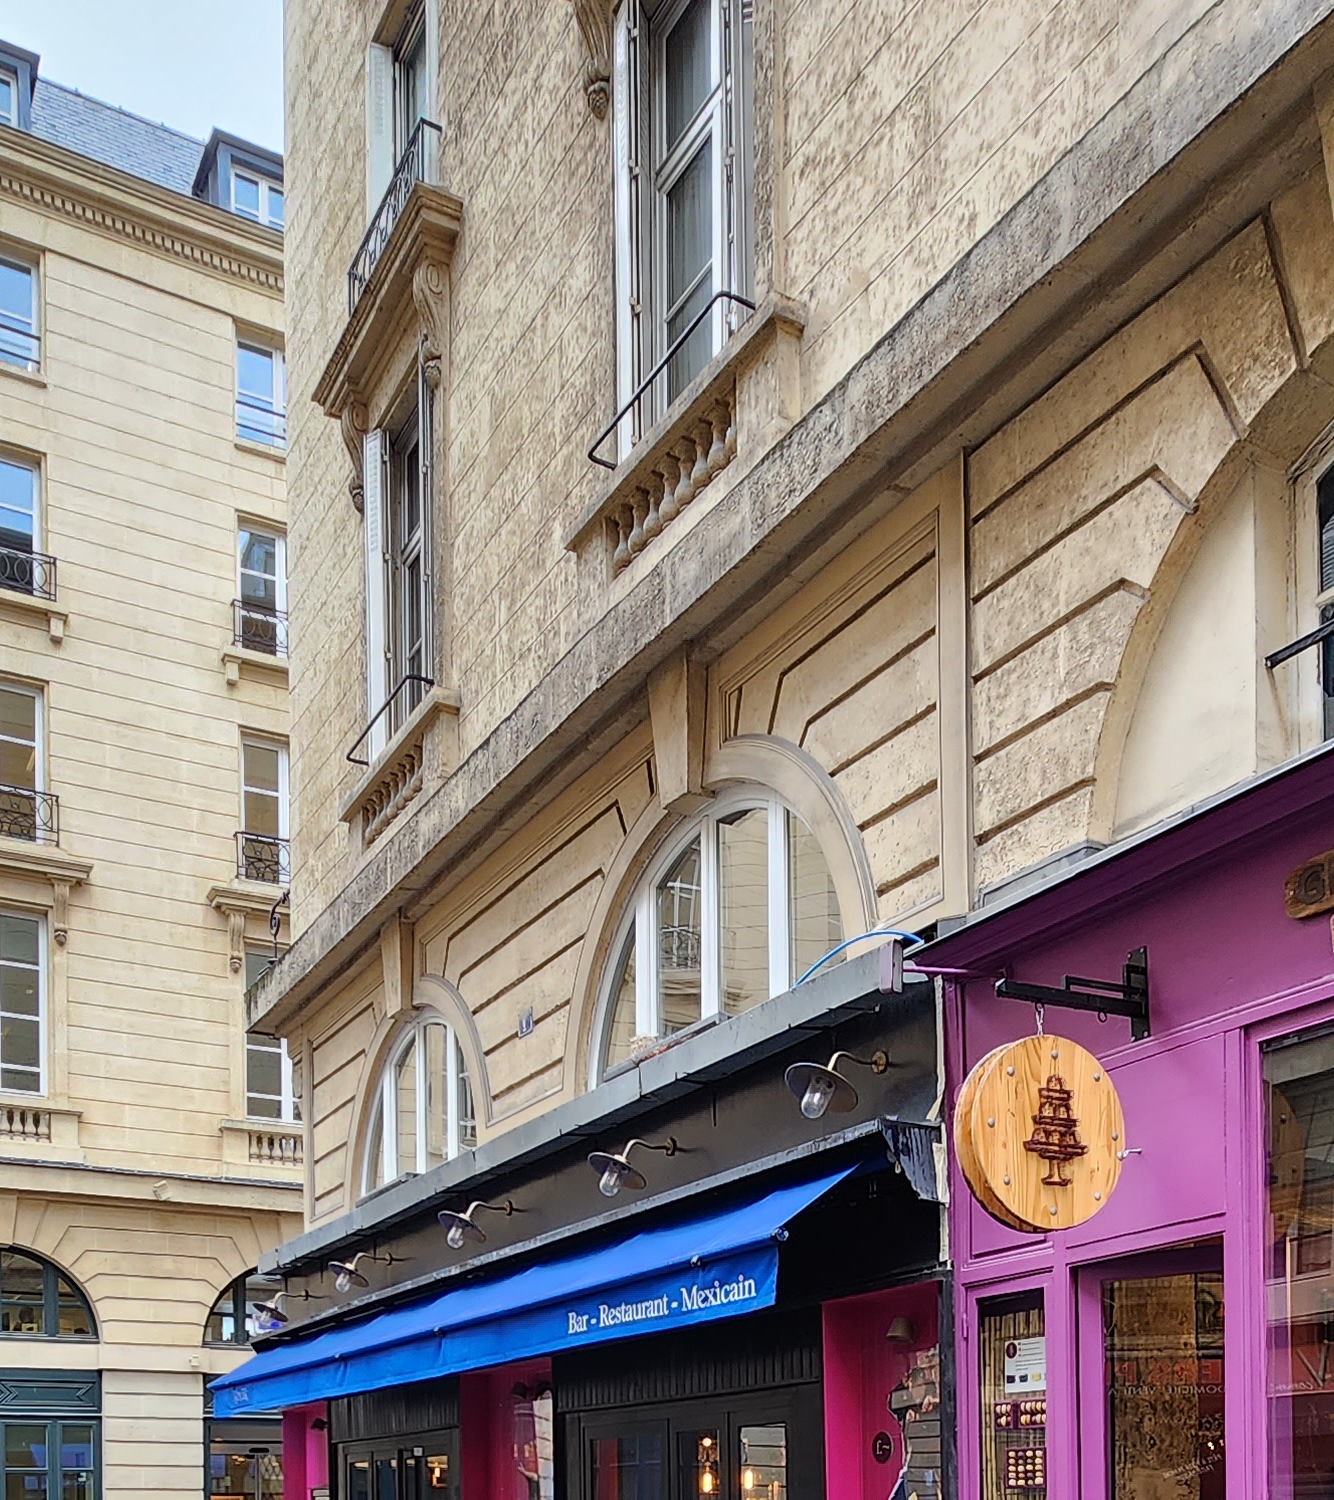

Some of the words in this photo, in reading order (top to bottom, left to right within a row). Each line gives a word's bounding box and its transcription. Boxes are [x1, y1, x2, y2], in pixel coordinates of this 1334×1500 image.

[568, 1311, 589, 1335] Bar
[598, 1293, 670, 1328] Restaurant
[680, 1274, 757, 1312] Mexicain
